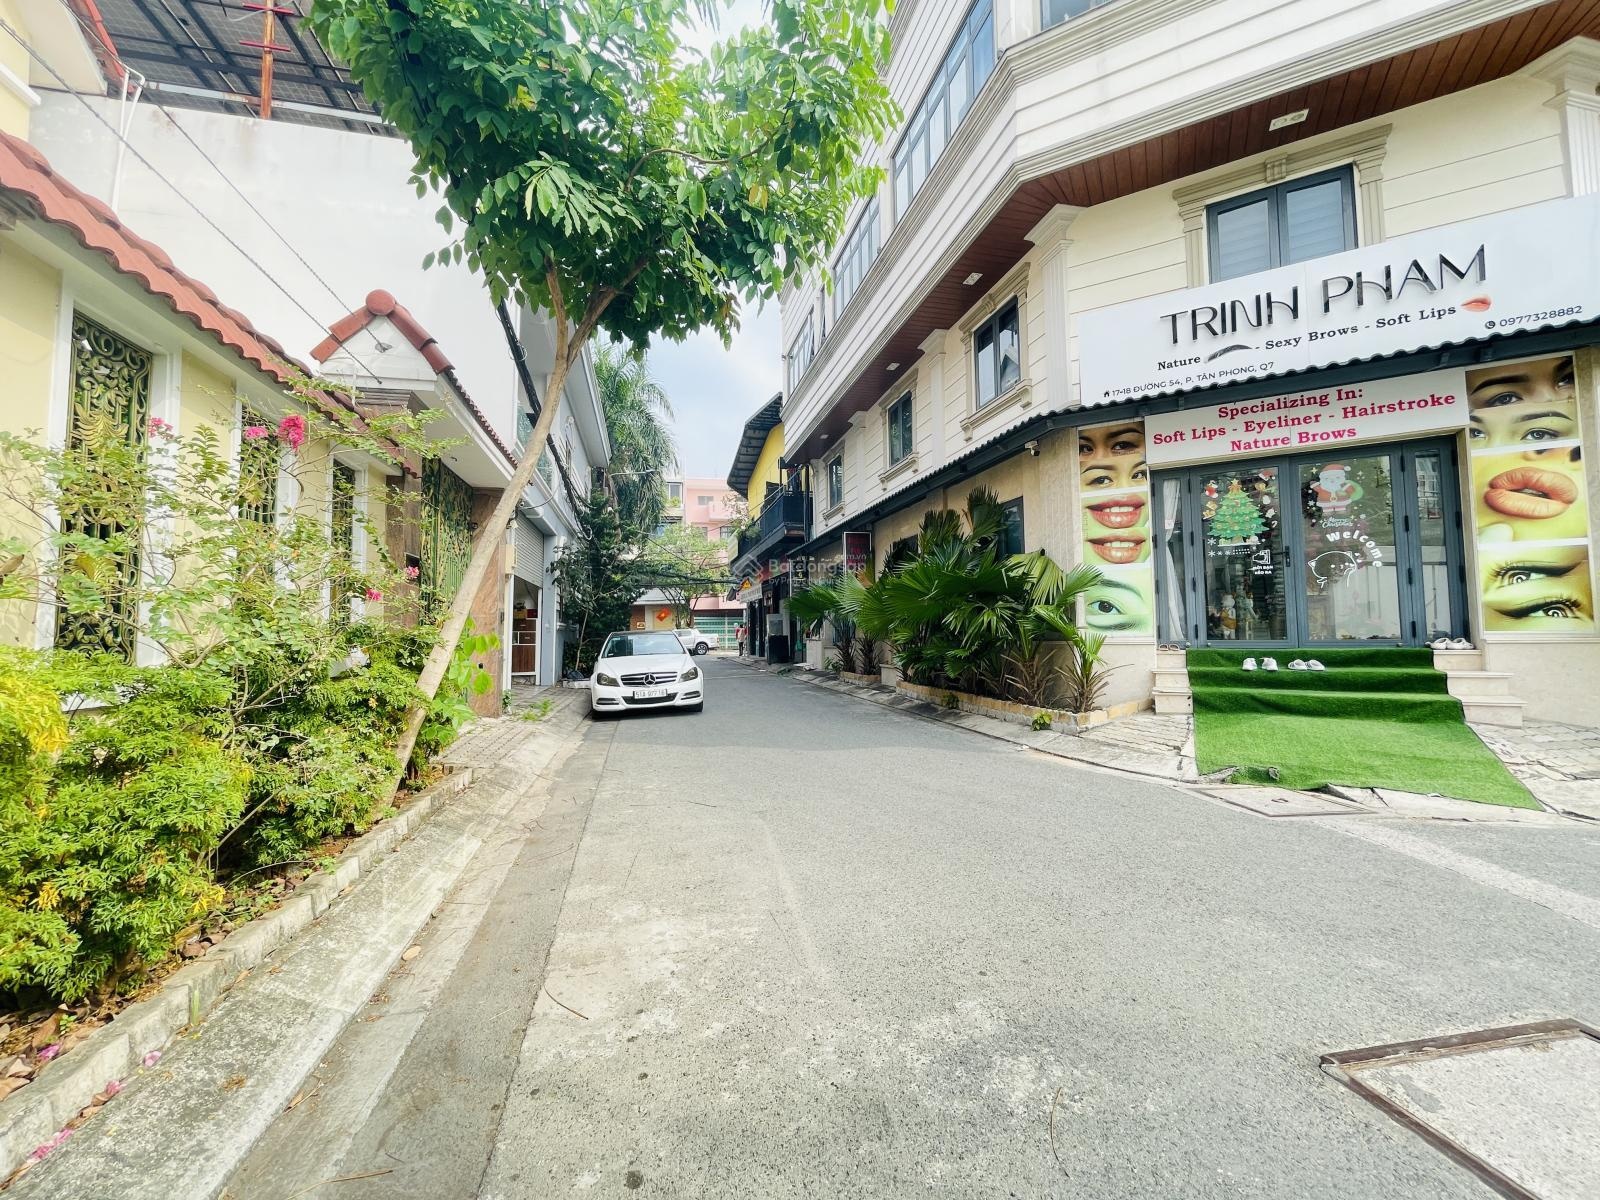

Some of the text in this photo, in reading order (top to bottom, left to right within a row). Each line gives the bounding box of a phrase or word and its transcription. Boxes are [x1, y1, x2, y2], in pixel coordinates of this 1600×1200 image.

[1160, 244, 1486, 344] TRINH PHAM
[1499, 305, 1583, 327] 0977328882
[1158, 356, 1201, 370] Nature
[1265, 336, 1302, 350] Sexy
[1308, 326, 1359, 342] Brows
[1375, 313, 1411, 329] Soft
[1419, 305, 1457, 321] Lips
[1112, 387, 1132, 397] 17-18
[1169, 378, 1183, 387] 54,
[1185, 375, 1194, 384] P.
[1197, 370, 1216, 382] TÂN
[1219, 364, 1257, 377] PHONG,
[1259, 361, 1274, 371] Q7
[1153, 430, 1186, 445] Soft
[1191, 426, 1226, 440] Lips
[1243, 413, 1322, 434] Eyeliner
[1342, 394, 1456, 419] Hairstroke
[1218, 388, 1363, 420] Specializing In:
[1230, 427, 1357, 451] Nature Brows
